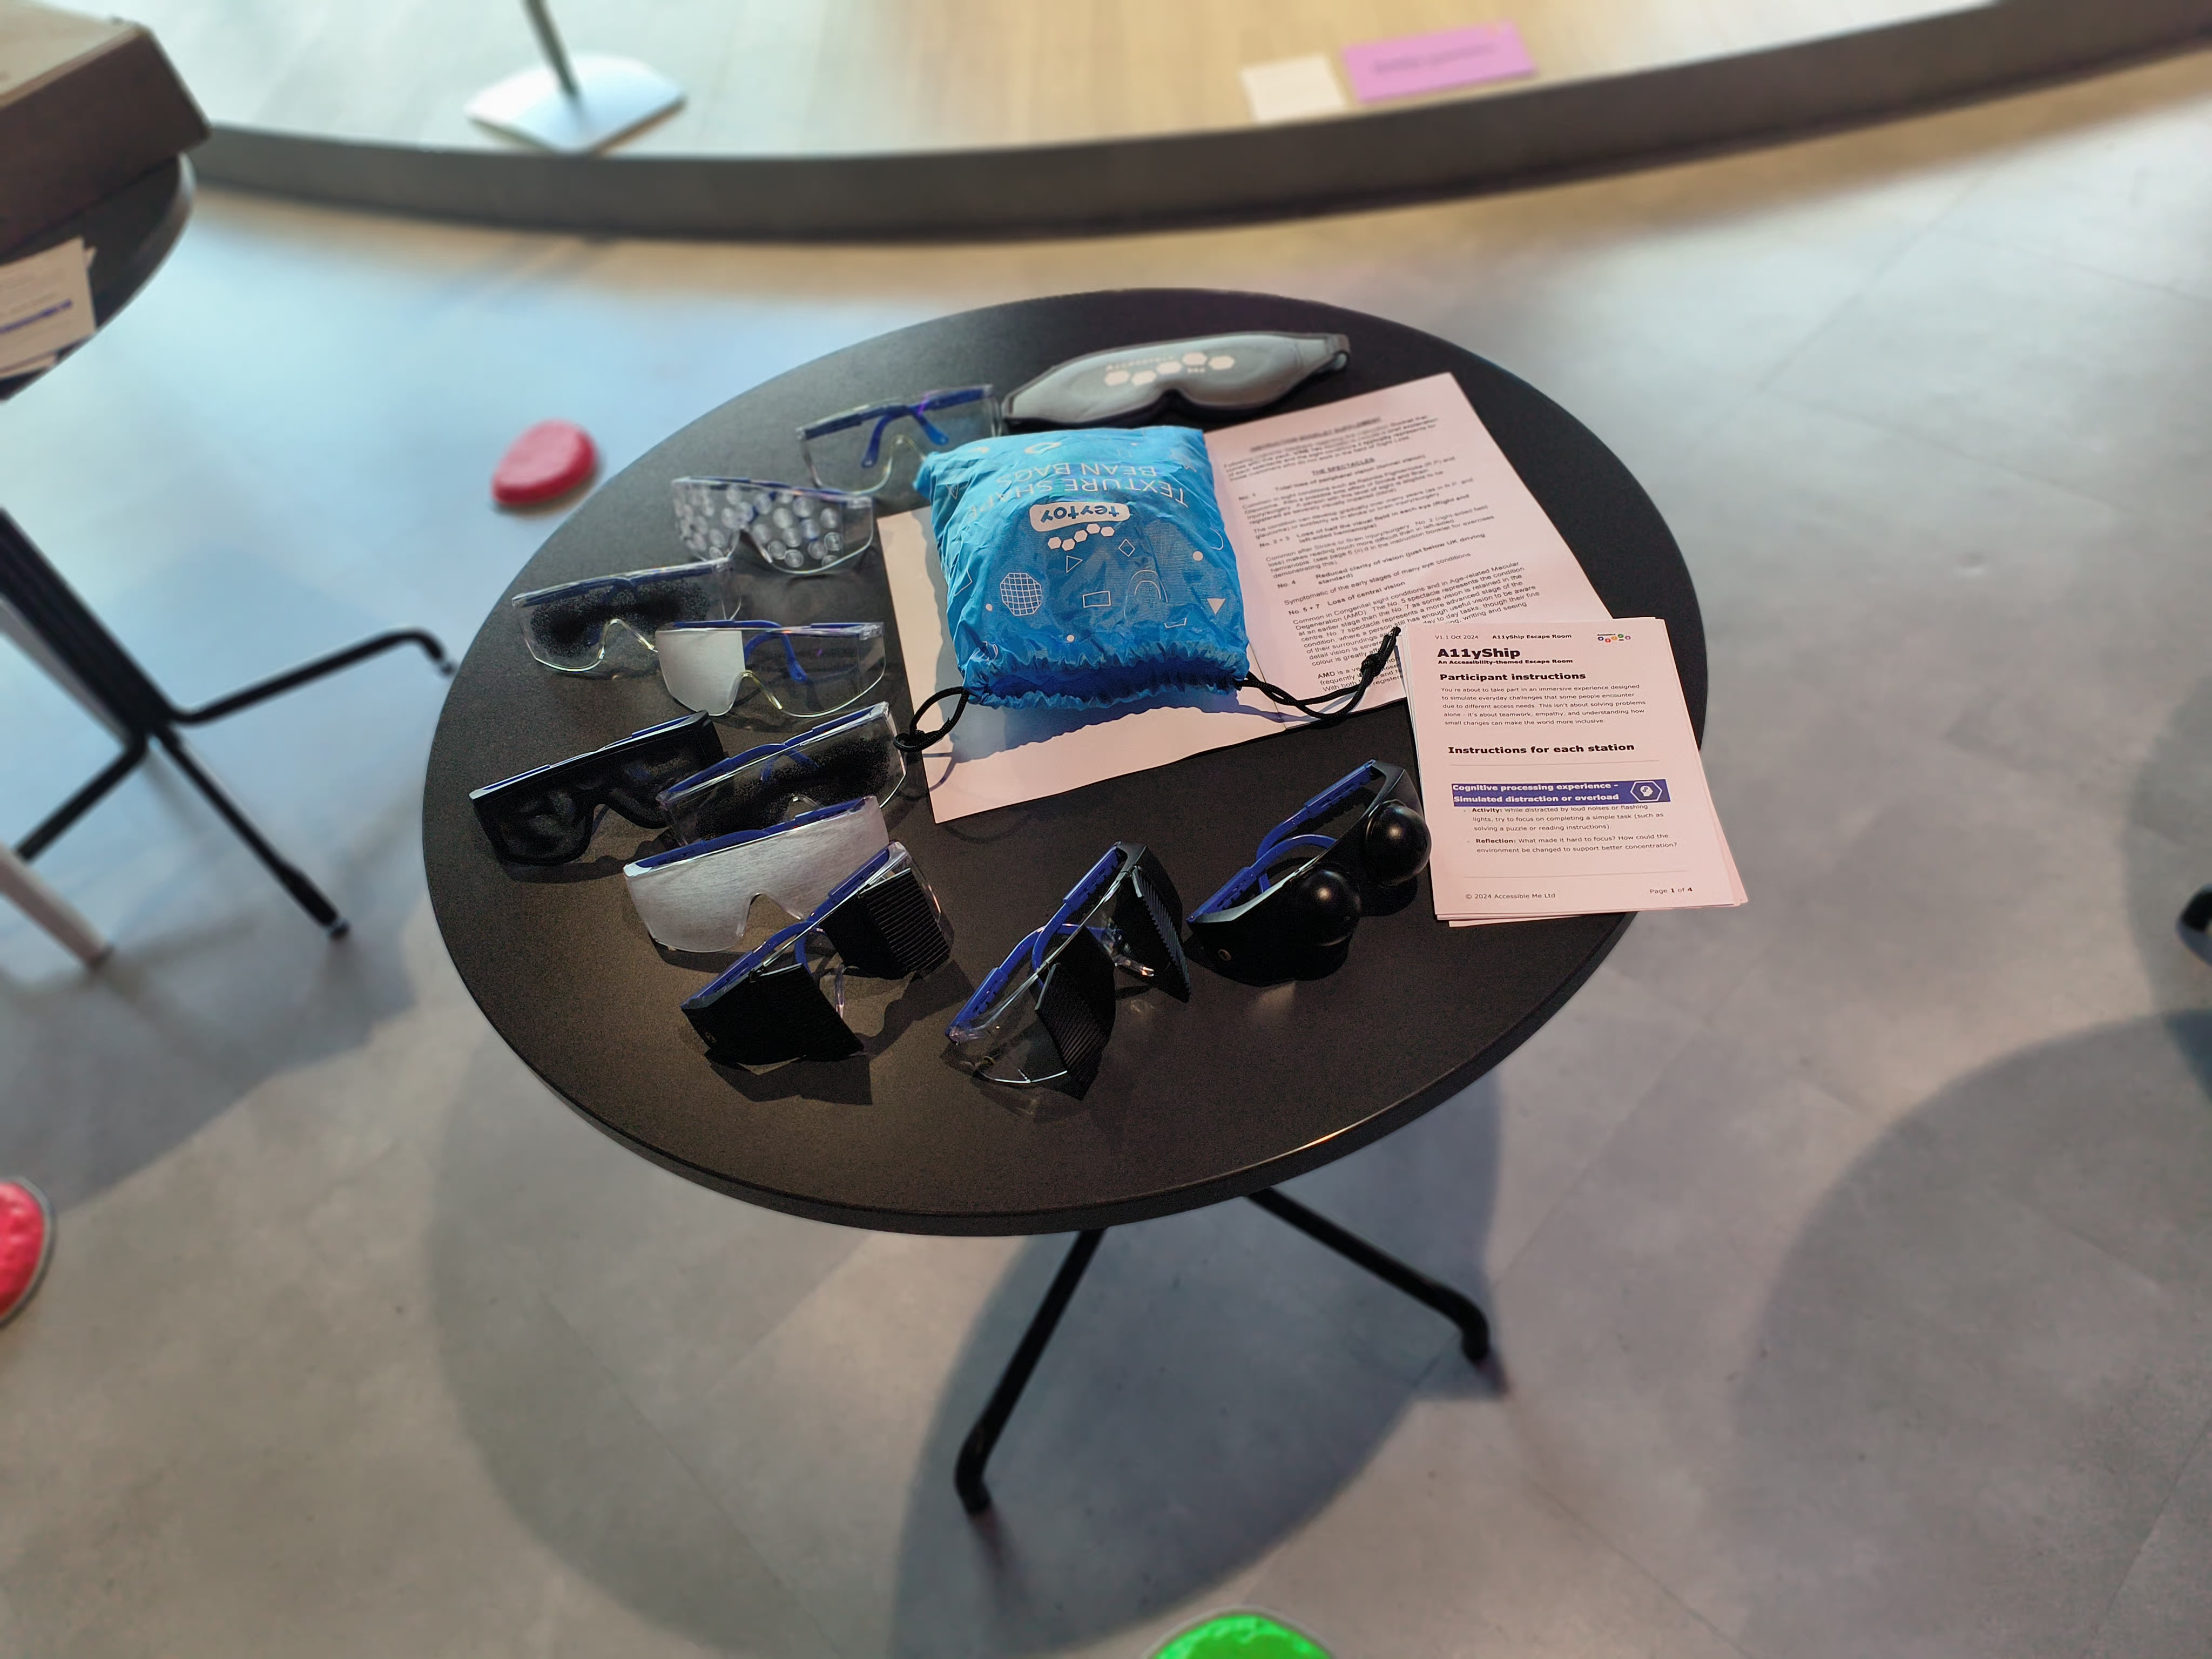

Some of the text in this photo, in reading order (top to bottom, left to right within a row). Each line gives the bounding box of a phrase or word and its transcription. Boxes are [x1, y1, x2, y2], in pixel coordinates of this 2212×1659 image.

[997, 463, 1157, 487] BEAN BAGS
[1065, 478, 1188, 508] TEXTURE
[1041, 505, 1120, 523] teytoy
[1284, 590, 1328, 605] Symptomatic
[1368, 574, 1392, 583] stages
[1401, 566, 1420, 574] many
[1435, 553, 1471, 564] conditions
[1292, 615, 1324, 625] Common
[1333, 602, 1371, 616] Congenital
[1372, 596, 1389, 605] sight
[1390, 587, 1425, 599] conditions
[1449, 568, 1490, 584] Age-related
[1491, 562, 1519, 571] Macular
[1327, 598, 1346, 606] Loss
[1357, 587, 1382, 598] central
[1383, 581, 1405, 590] vision
[1437, 648, 1520, 659] A11yShip
[1440, 673, 1508, 682] Participant
[1553, 745, 1584, 753] each
[1588, 744, 1635, 752] station
